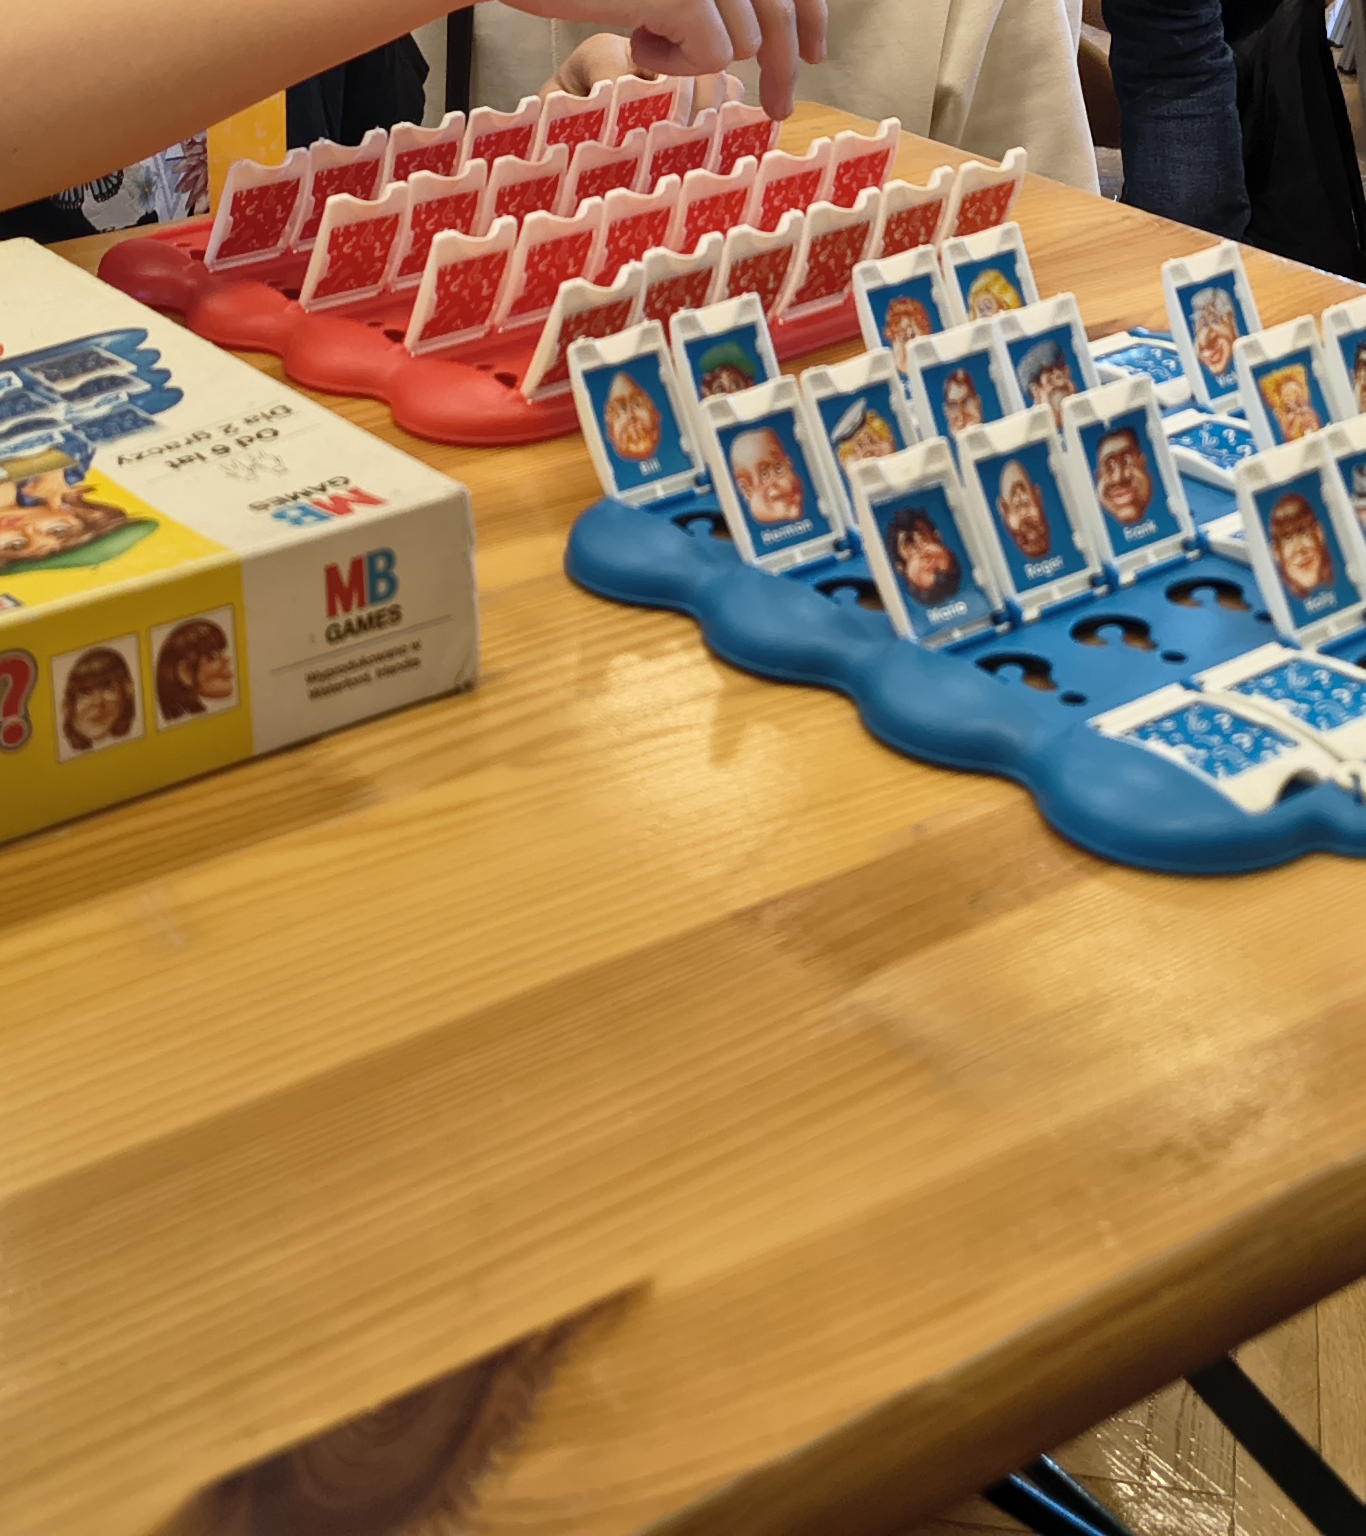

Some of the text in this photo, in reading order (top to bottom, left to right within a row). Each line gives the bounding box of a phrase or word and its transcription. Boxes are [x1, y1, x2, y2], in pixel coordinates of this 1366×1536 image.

[116, 404, 293, 468] Dla 2 graczy
[235, 427, 280, 448] Od
[164, 451, 206, 471] lat
[638, 457, 663, 477] Bill
[248, 475, 351, 515] GAMES
[269, 487, 388, 530] MB
[1122, 518, 1159, 543] Frank
[323, 547, 400, 619] MB
[1023, 554, 1065, 580] Roger
[324, 604, 403, 645] GAMES
